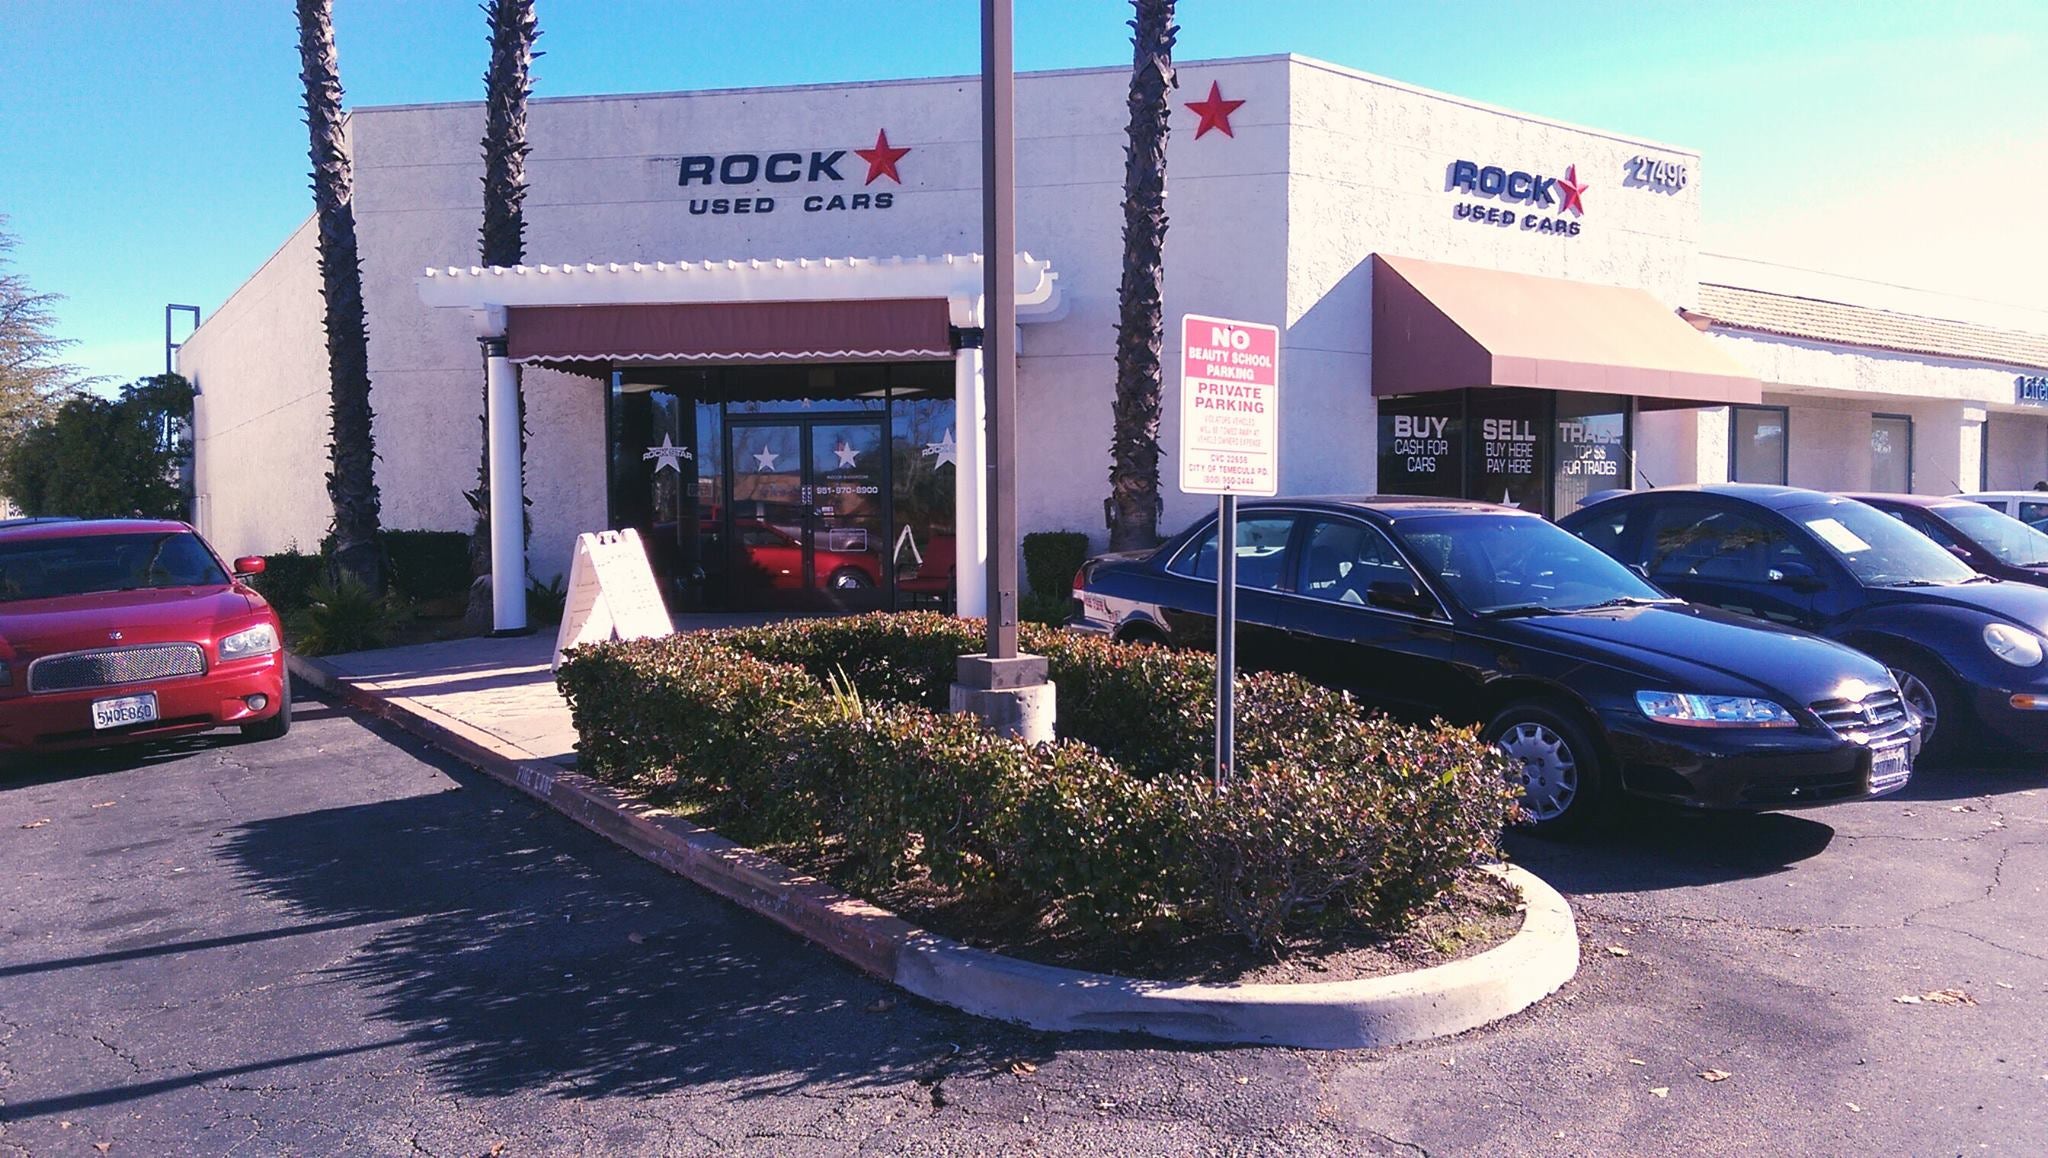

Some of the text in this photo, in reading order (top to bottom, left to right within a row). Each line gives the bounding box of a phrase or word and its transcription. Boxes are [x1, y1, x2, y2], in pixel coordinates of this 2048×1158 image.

[678, 150, 847, 187] ROCK
[1635, 156, 1688, 188] 27496
[1452, 159, 1557, 205] ROCK
[689, 192, 894, 215] USED CARS
[1457, 202, 1581, 236] USED CARS
[1211, 326, 1251, 350] NO
[1188, 346, 1272, 368] BEAUTY SCHOOL
[1206, 364, 1255, 380] PARKING
[1198, 382, 1262, 399] PRIVATE
[1195, 396, 1264, 413] PARKING
[1394, 415, 1448, 438] BUY
[1483, 418, 1536, 441] SELL
[1394, 439, 1448, 456] CASH FOR
[1485, 441, 1533, 458] BUY HERE
[1574, 444, 1592, 459] TOP
[1407, 456, 1436, 472] CARS
[1487, 458, 1532, 474] PAY HERE
[1562, 460, 1617, 476] FOR TRADES
